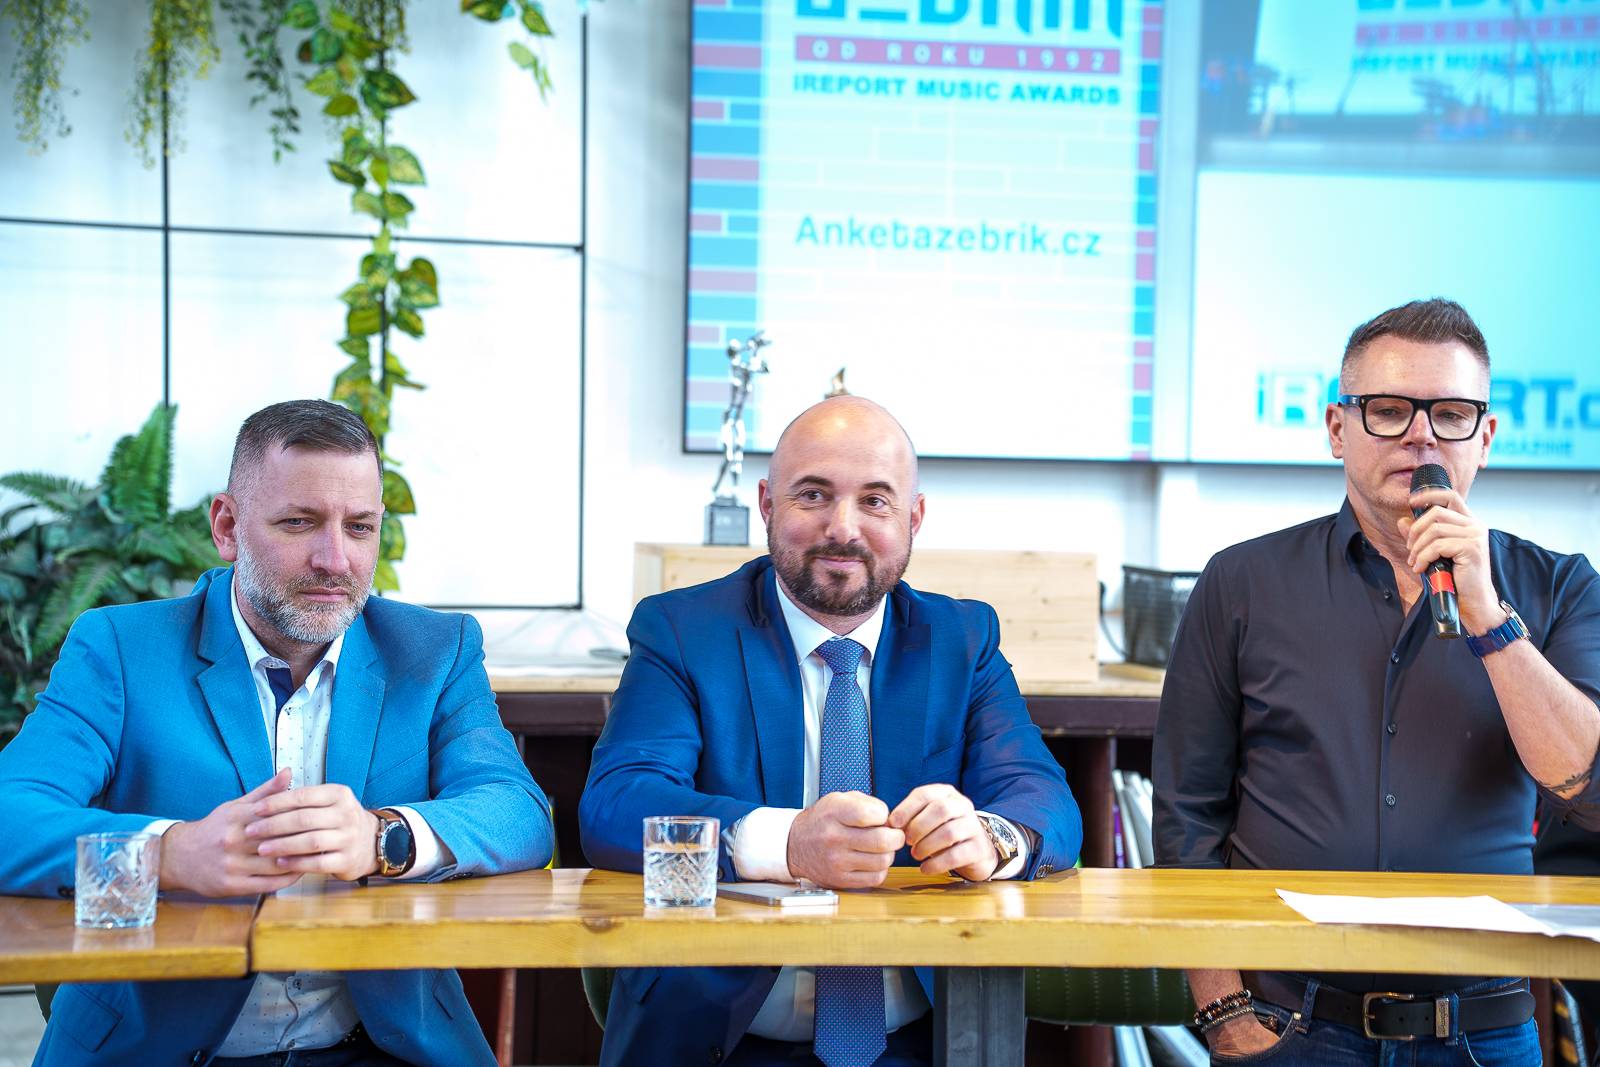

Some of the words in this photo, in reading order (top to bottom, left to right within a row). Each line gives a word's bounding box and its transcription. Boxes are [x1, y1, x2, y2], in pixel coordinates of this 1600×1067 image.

[812, 38, 856, 60] OD
[886, 42, 985, 66] ROKU
[1017, 48, 1105, 70] 1992
[794, 73, 906, 96] IREPORT
[916, 79, 1000, 100] MUSIC
[1010, 83, 1121, 105] AWARDS
[795, 213, 1103, 256] Anketazebrik.cz
